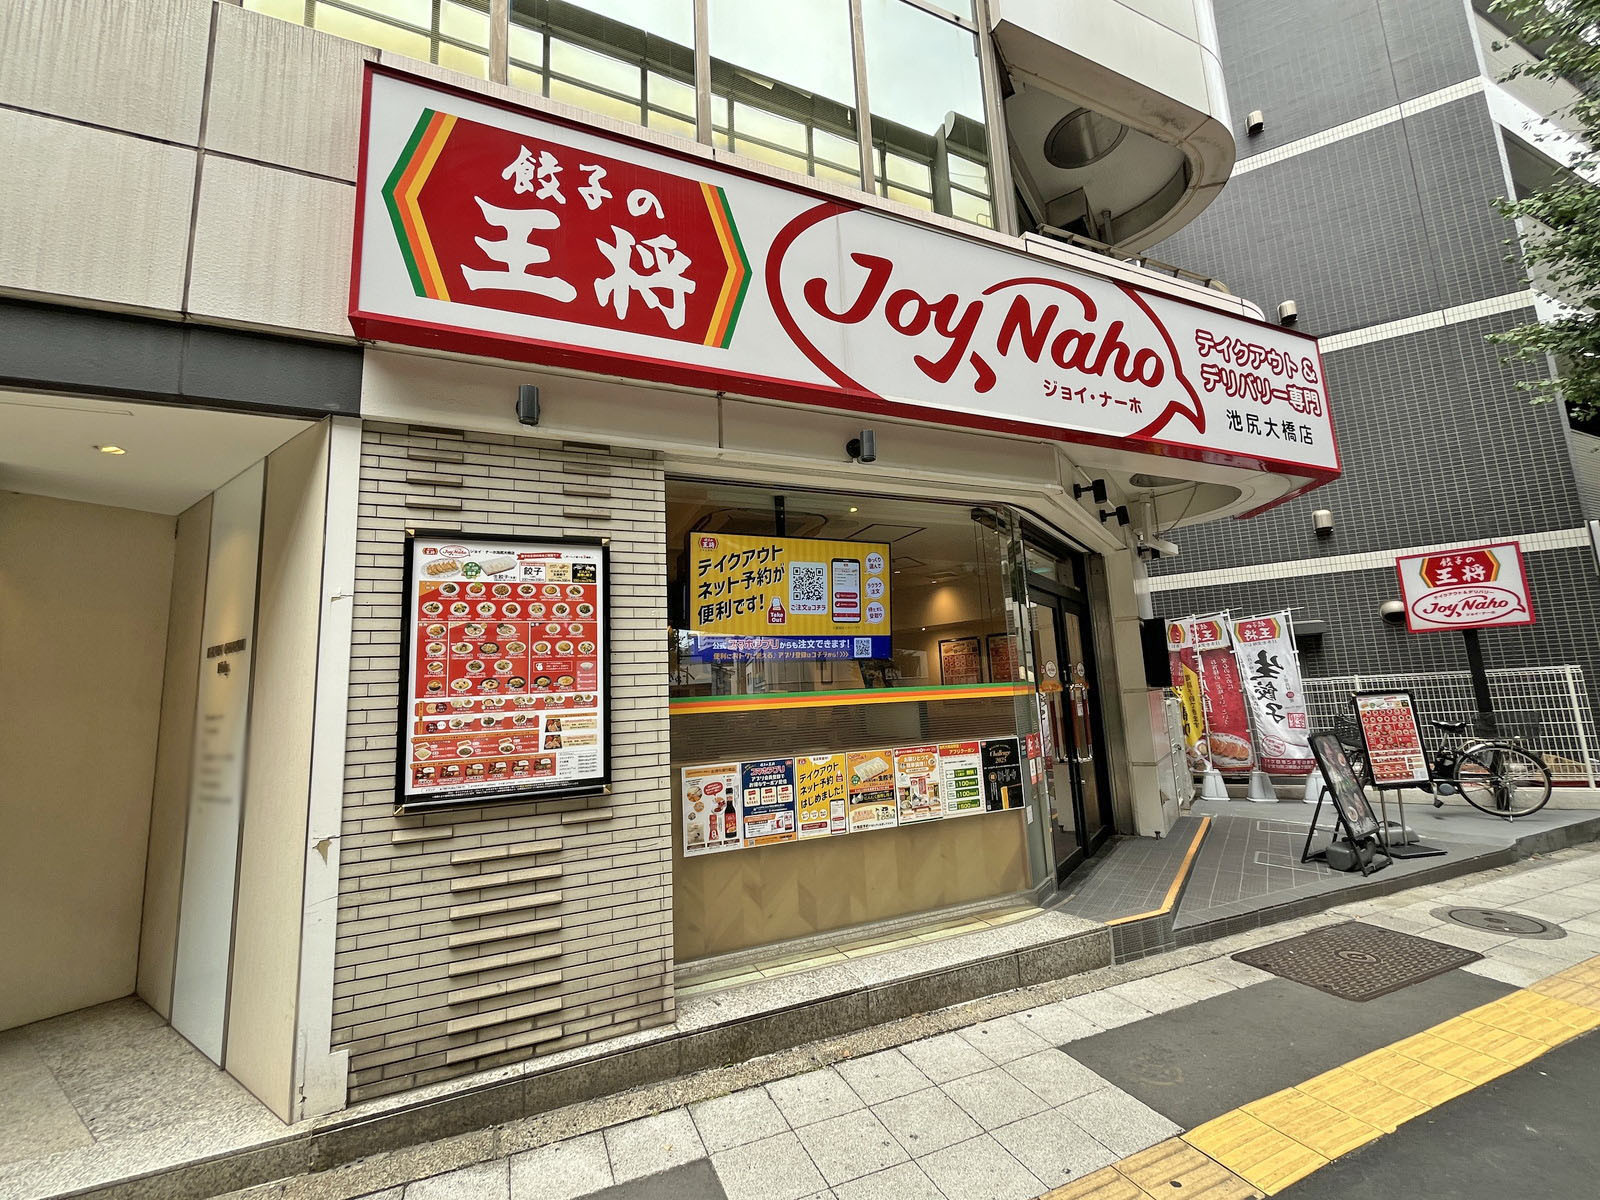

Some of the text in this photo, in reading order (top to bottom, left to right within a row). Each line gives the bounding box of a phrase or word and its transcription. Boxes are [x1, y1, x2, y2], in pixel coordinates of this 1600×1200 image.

[501, 144, 665, 220] 餃子の
[460, 195, 697, 330] 王将
[990, 285, 1165, 388] Naho
[1043, 379, 1143, 414] ジョイ・ナーホ
[1200, 363, 1322, 417] デリバリー専門
[1226, 409, 1313, 445] 池尻大橋店
[698, 544, 784, 577] テイクアウト
[1435, 564, 1486, 585] 王将
[1440, 556, 1475, 567] 餃子の
[698, 562, 785, 600] ネット予約が
[698, 593, 764, 625] 便利です!
[1461, 597, 1509, 610] Naho
[800, 761, 839, 783] テイクアウト
[800, 775, 834, 796] ネット予約
[801, 785, 844, 809] はじめました!
